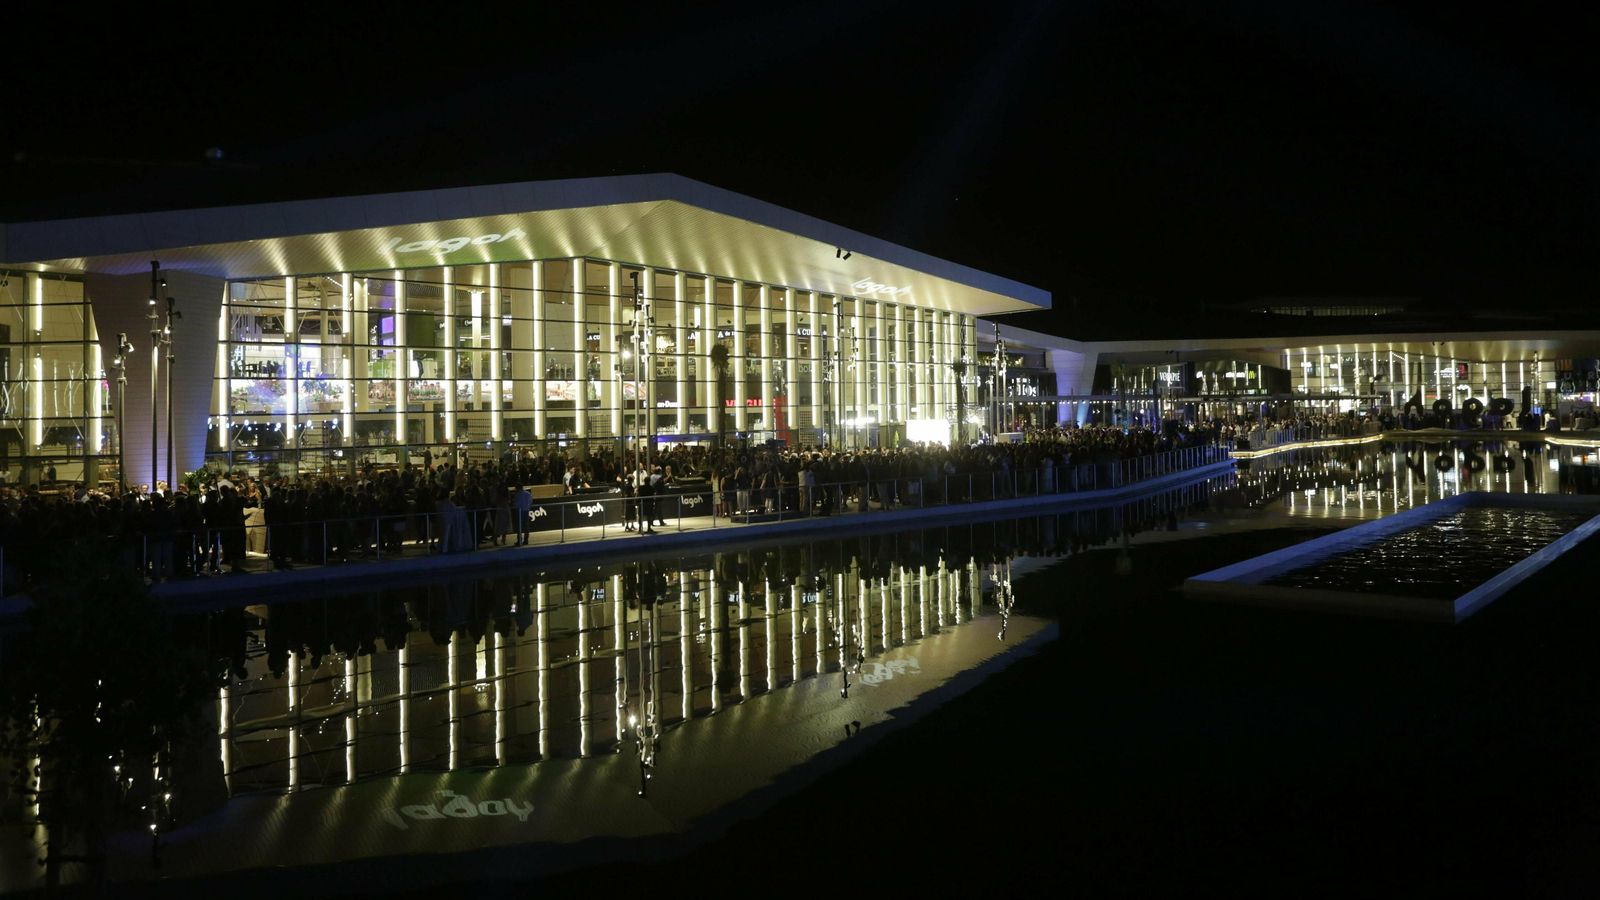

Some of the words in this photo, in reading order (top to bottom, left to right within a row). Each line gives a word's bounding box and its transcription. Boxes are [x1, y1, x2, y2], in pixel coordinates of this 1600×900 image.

[376, 226, 526, 257] lagoh
[681, 495, 703, 508] lagoh
[528, 506, 547, 521] goh
[577, 502, 604, 517] lagoh
